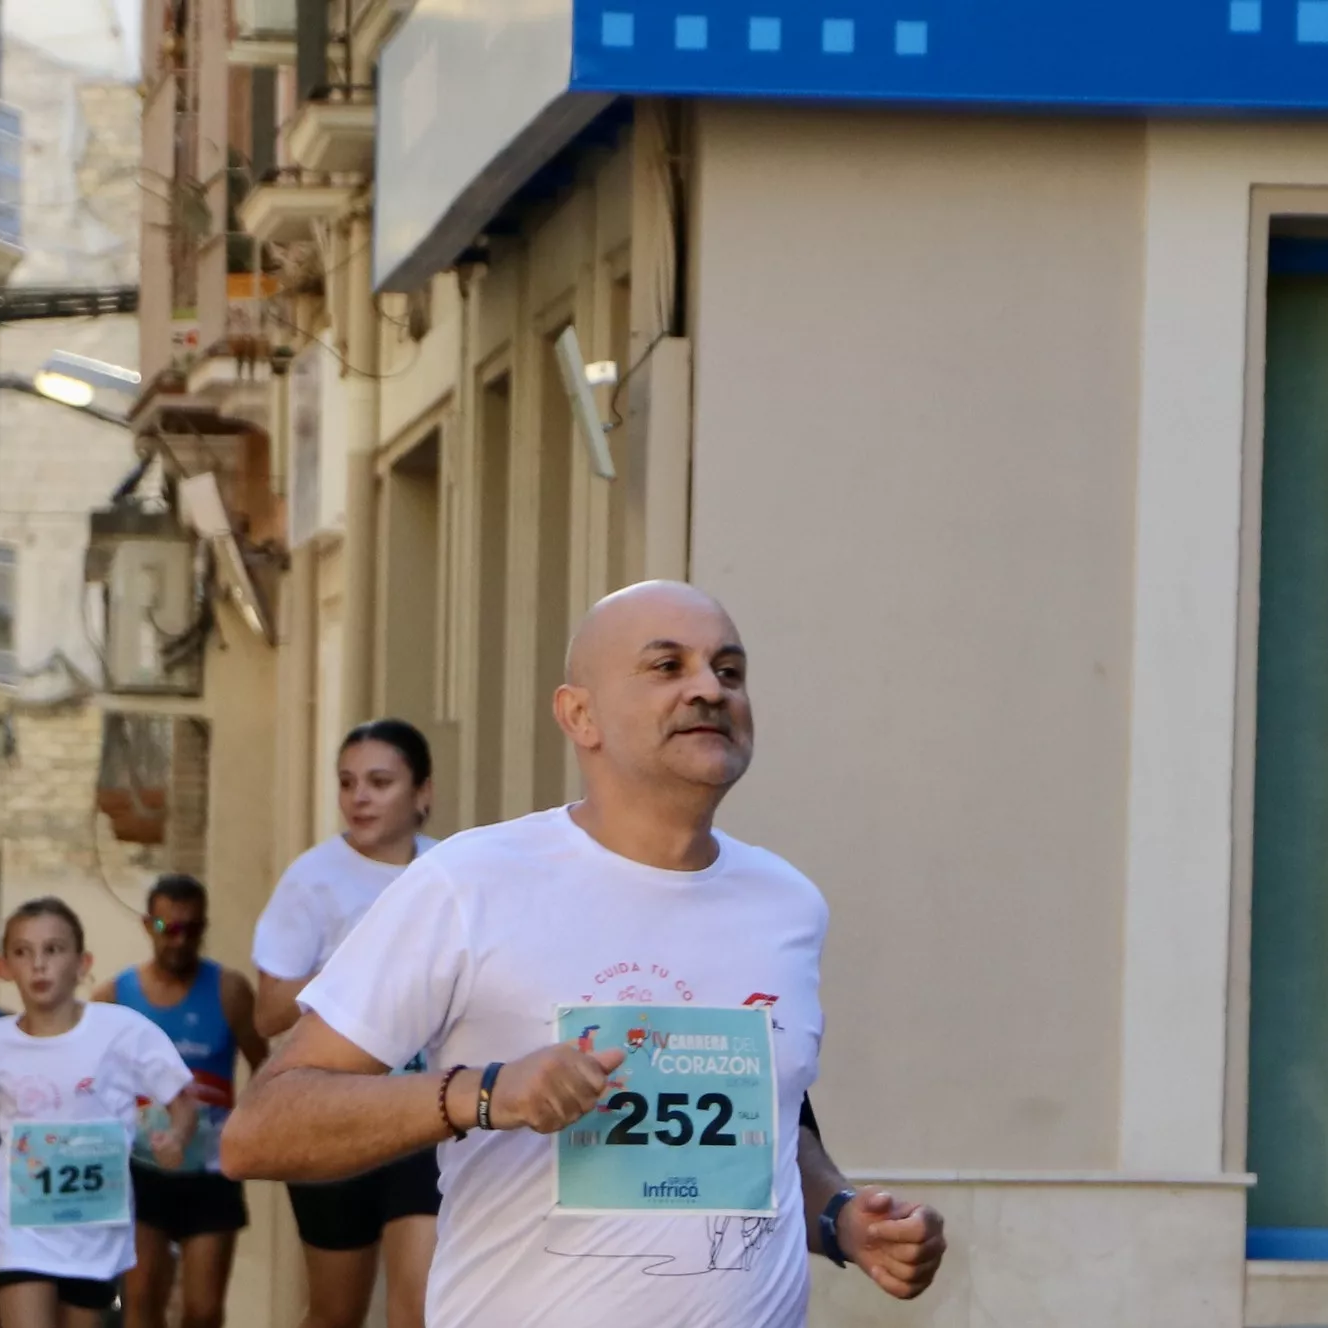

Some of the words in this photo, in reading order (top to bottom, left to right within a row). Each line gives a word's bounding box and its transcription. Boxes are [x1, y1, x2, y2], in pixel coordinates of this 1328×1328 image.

[594, 962, 641, 984] CUIDA
[651, 964, 670, 979] TU
[674, 980, 694, 1002] CO
[669, 1034, 729, 1051] CARRERA
[605, 1091, 737, 1147] 252
[34, 1163, 105, 1195] 125
[642, 1180, 699, 1198] Infrico
